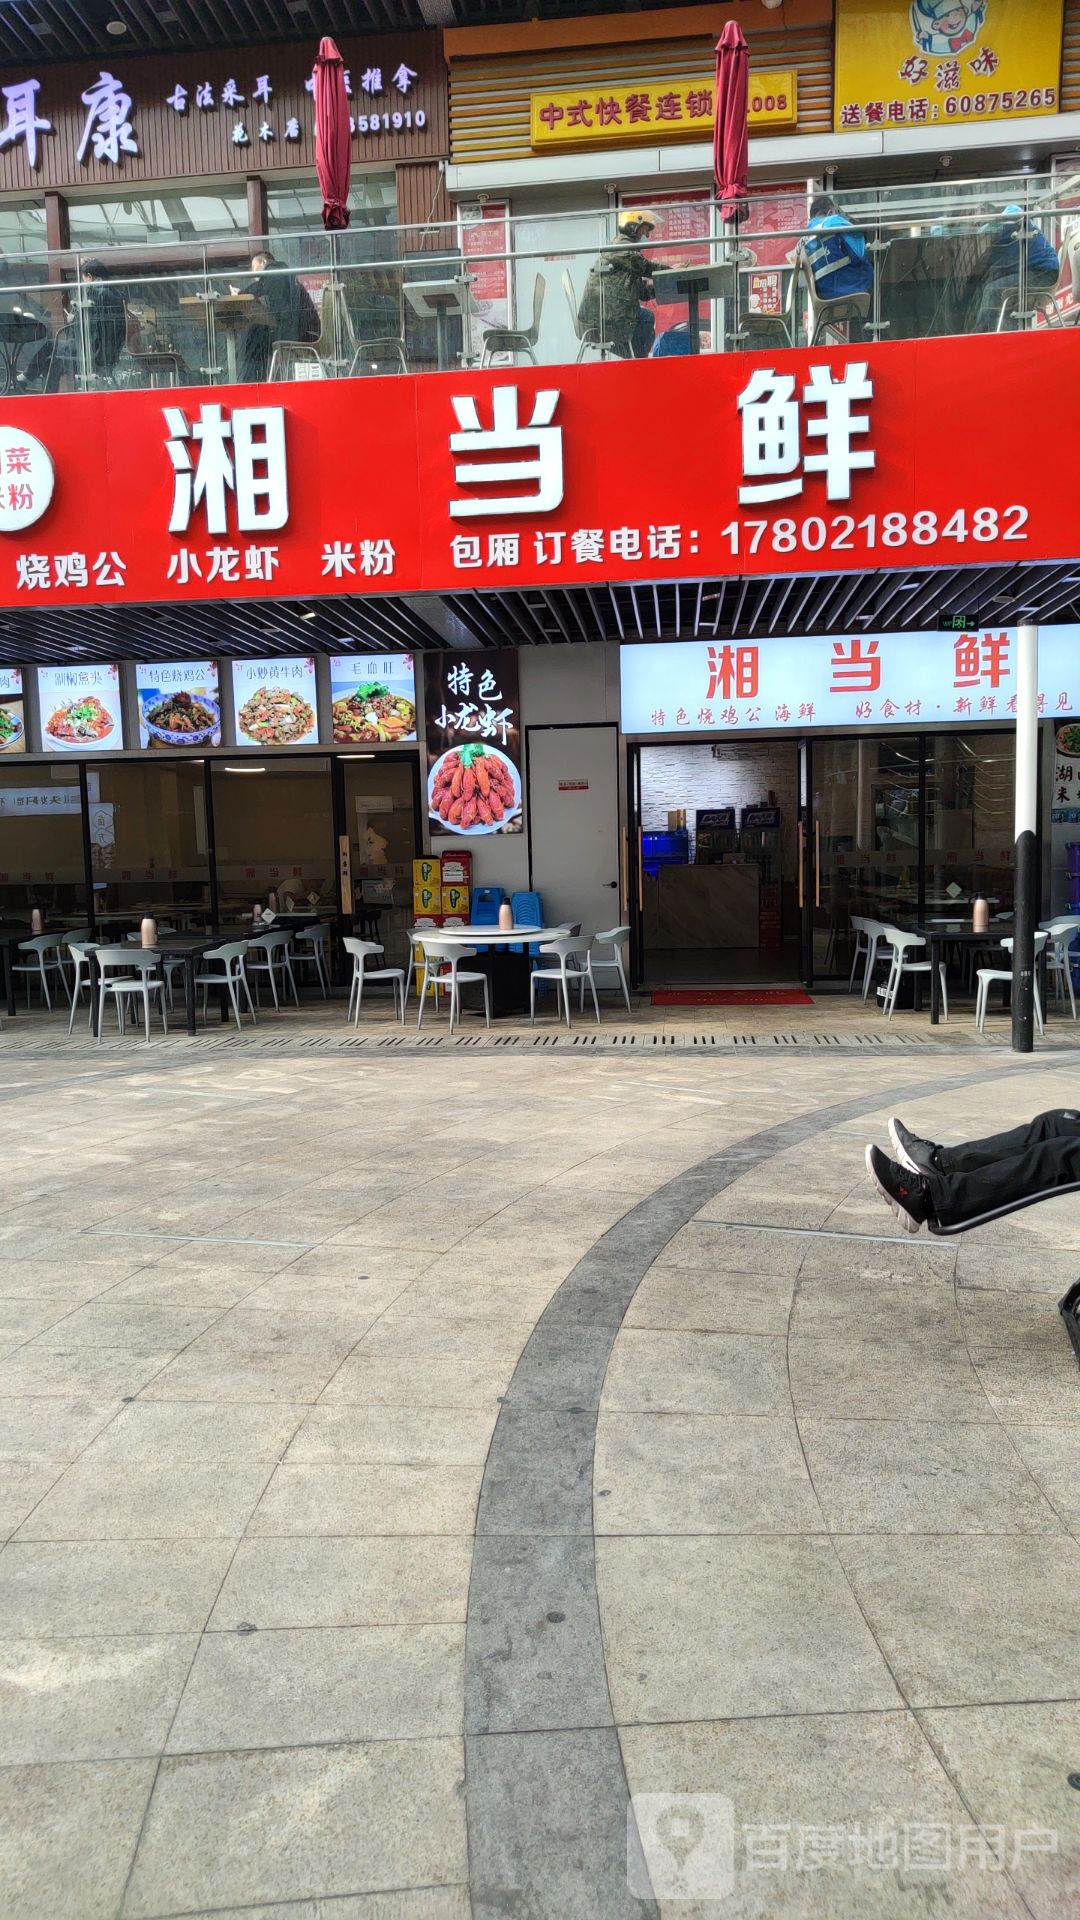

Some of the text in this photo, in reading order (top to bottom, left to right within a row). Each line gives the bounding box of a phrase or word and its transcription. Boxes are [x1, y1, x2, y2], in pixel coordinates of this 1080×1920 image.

[899, 47, 999, 91] 好滋味
[166, 75, 273, 112] 古法采耳
[0, 447, 32, 474] 菜
[0, 484, 34, 511] 粉
[16, 538, 396, 590] 烧鸡公 小龙虾 米粉
[447, 662, 503, 700] 特色
[706, 632, 1011, 699] 湘当鲜
[434, 702, 514, 746] 小龙虾
